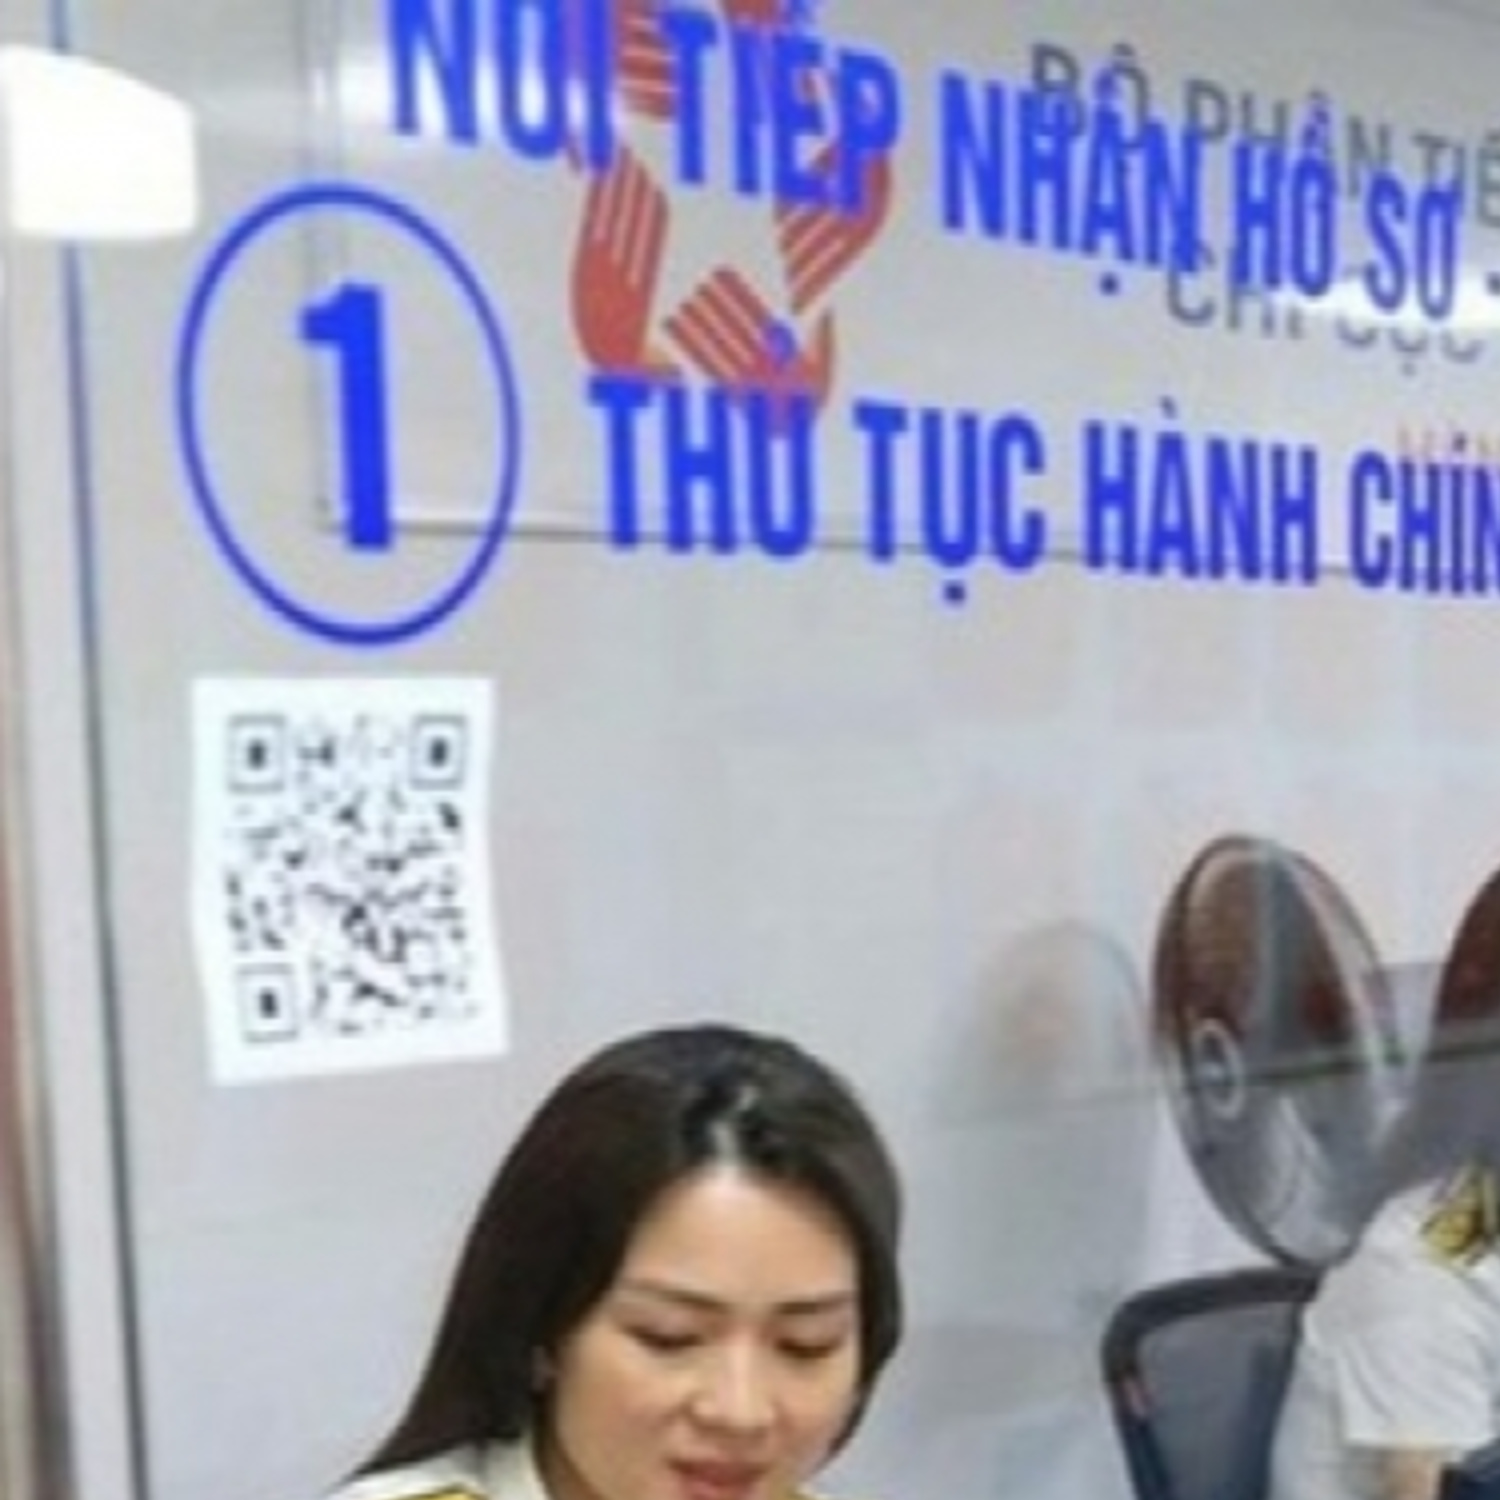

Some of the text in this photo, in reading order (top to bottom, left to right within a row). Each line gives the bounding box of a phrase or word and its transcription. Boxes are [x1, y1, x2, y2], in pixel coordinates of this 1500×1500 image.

[660, 0, 898, 212] TIẾP
[940, 65, 1203, 295] NHẬN
[1232, 95, 1337, 298] HỒ
[1364, 168, 1465, 320] SƠ
[299, 283, 393, 551] 1
[590, 318, 814, 556] THỦ
[854, 398, 1046, 605] TỤC
[1083, 396, 1320, 588] HÀNH
